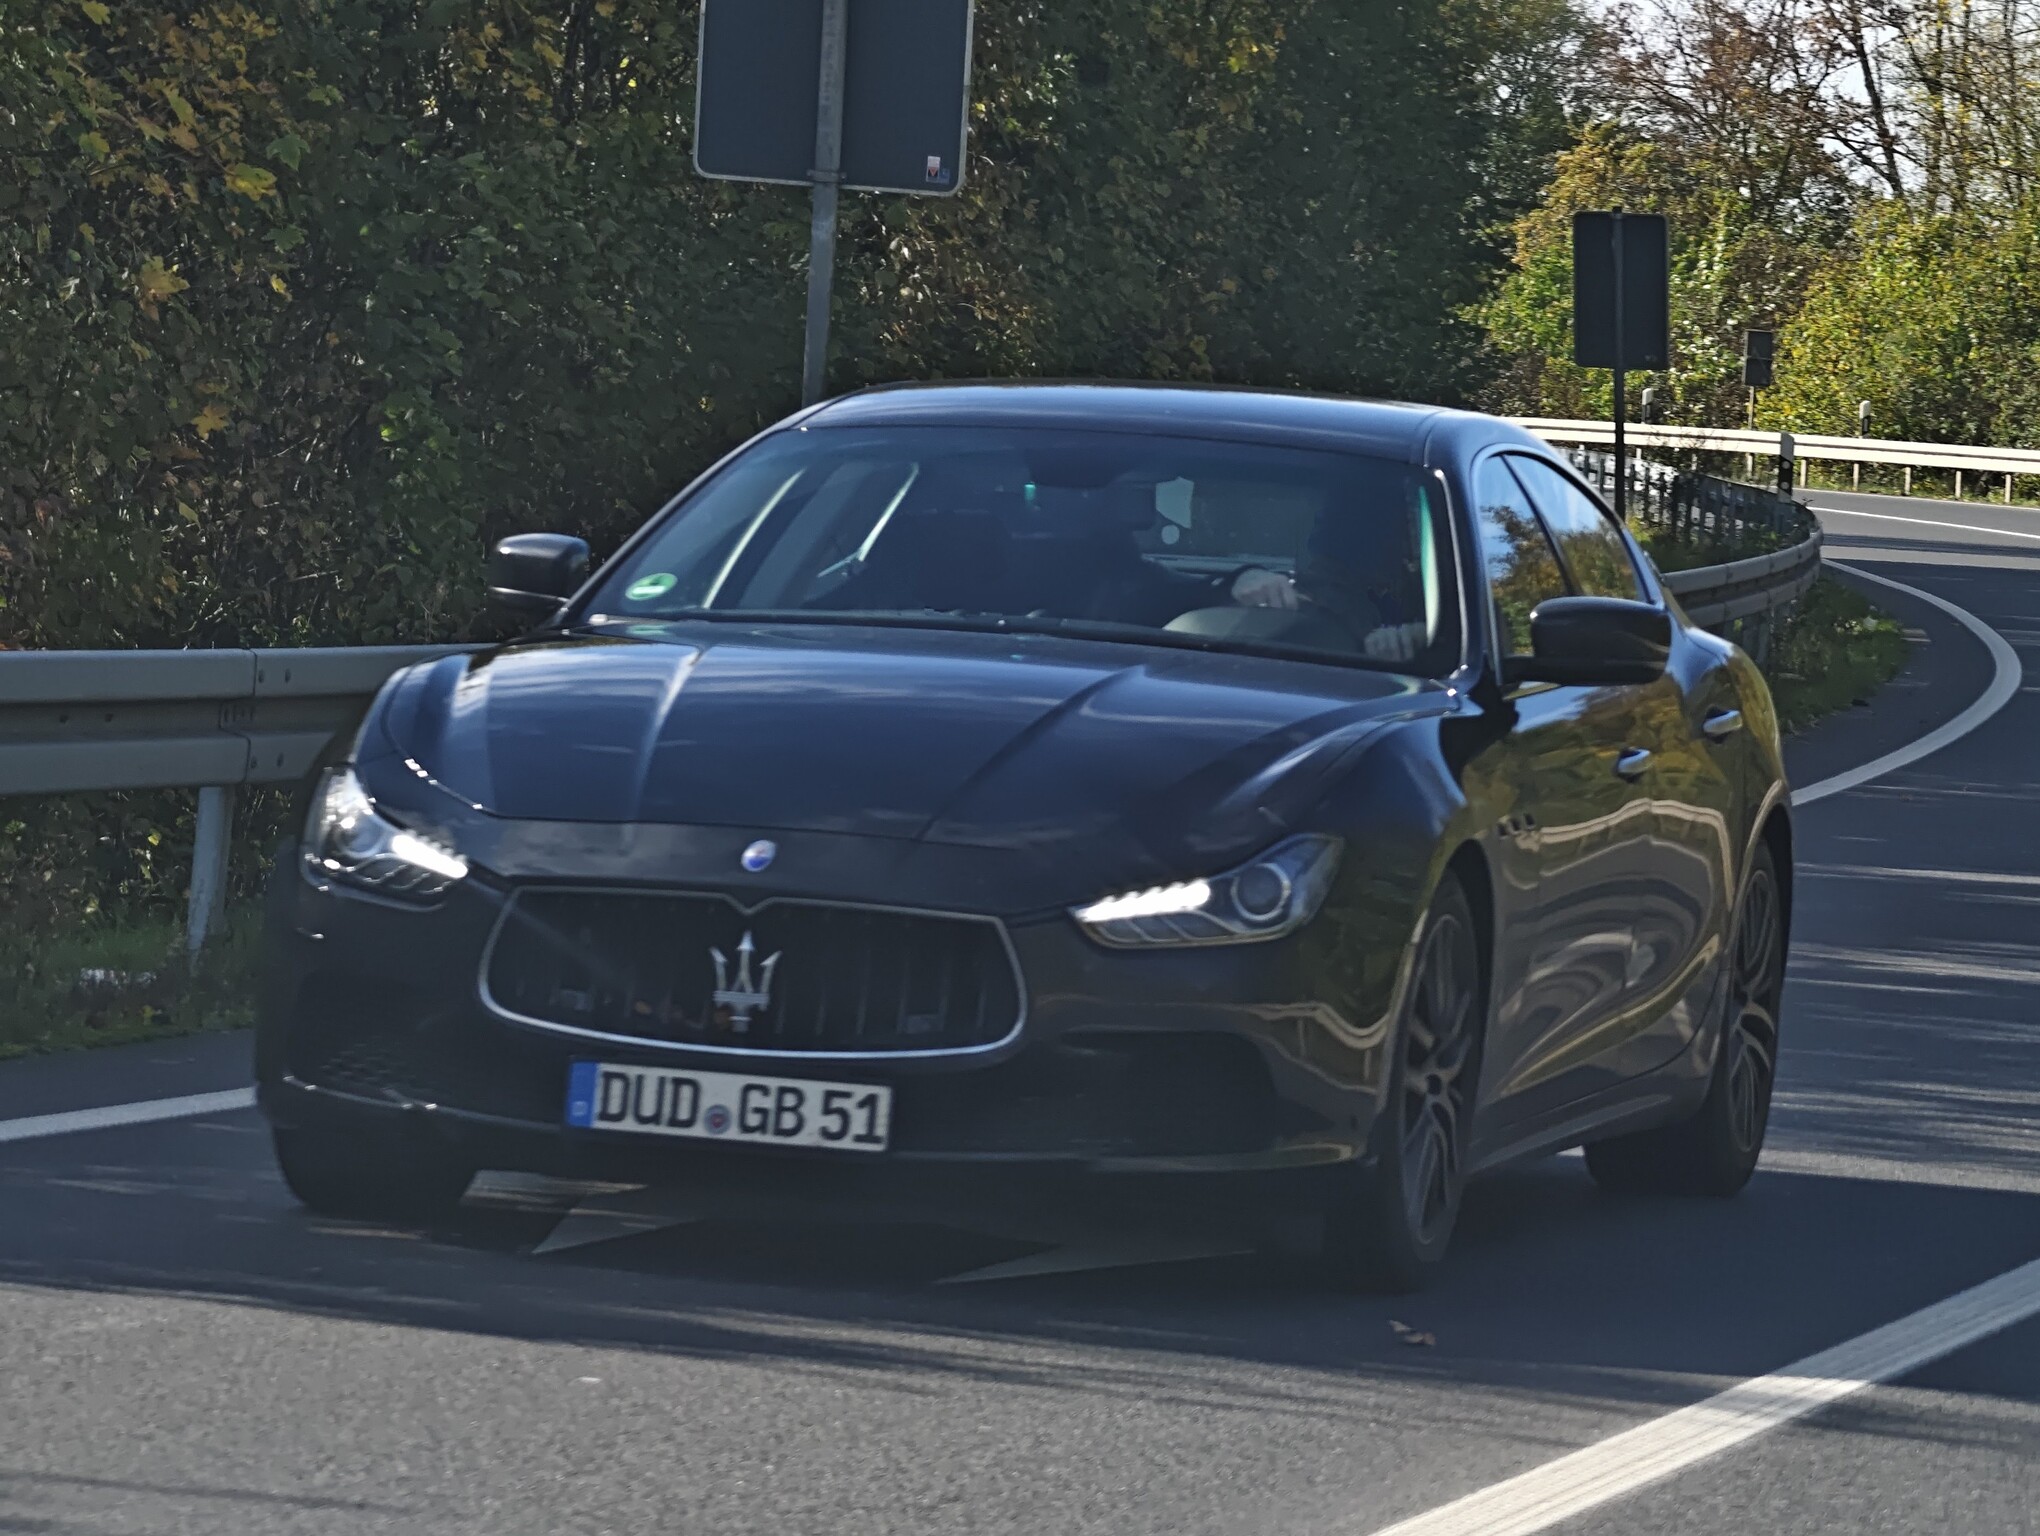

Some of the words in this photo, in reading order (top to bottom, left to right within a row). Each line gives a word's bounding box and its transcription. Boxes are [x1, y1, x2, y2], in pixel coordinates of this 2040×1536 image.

[598, 1071, 701, 1128] DUD
[738, 1083, 805, 1137] GB
[819, 1090, 885, 1144] 51
